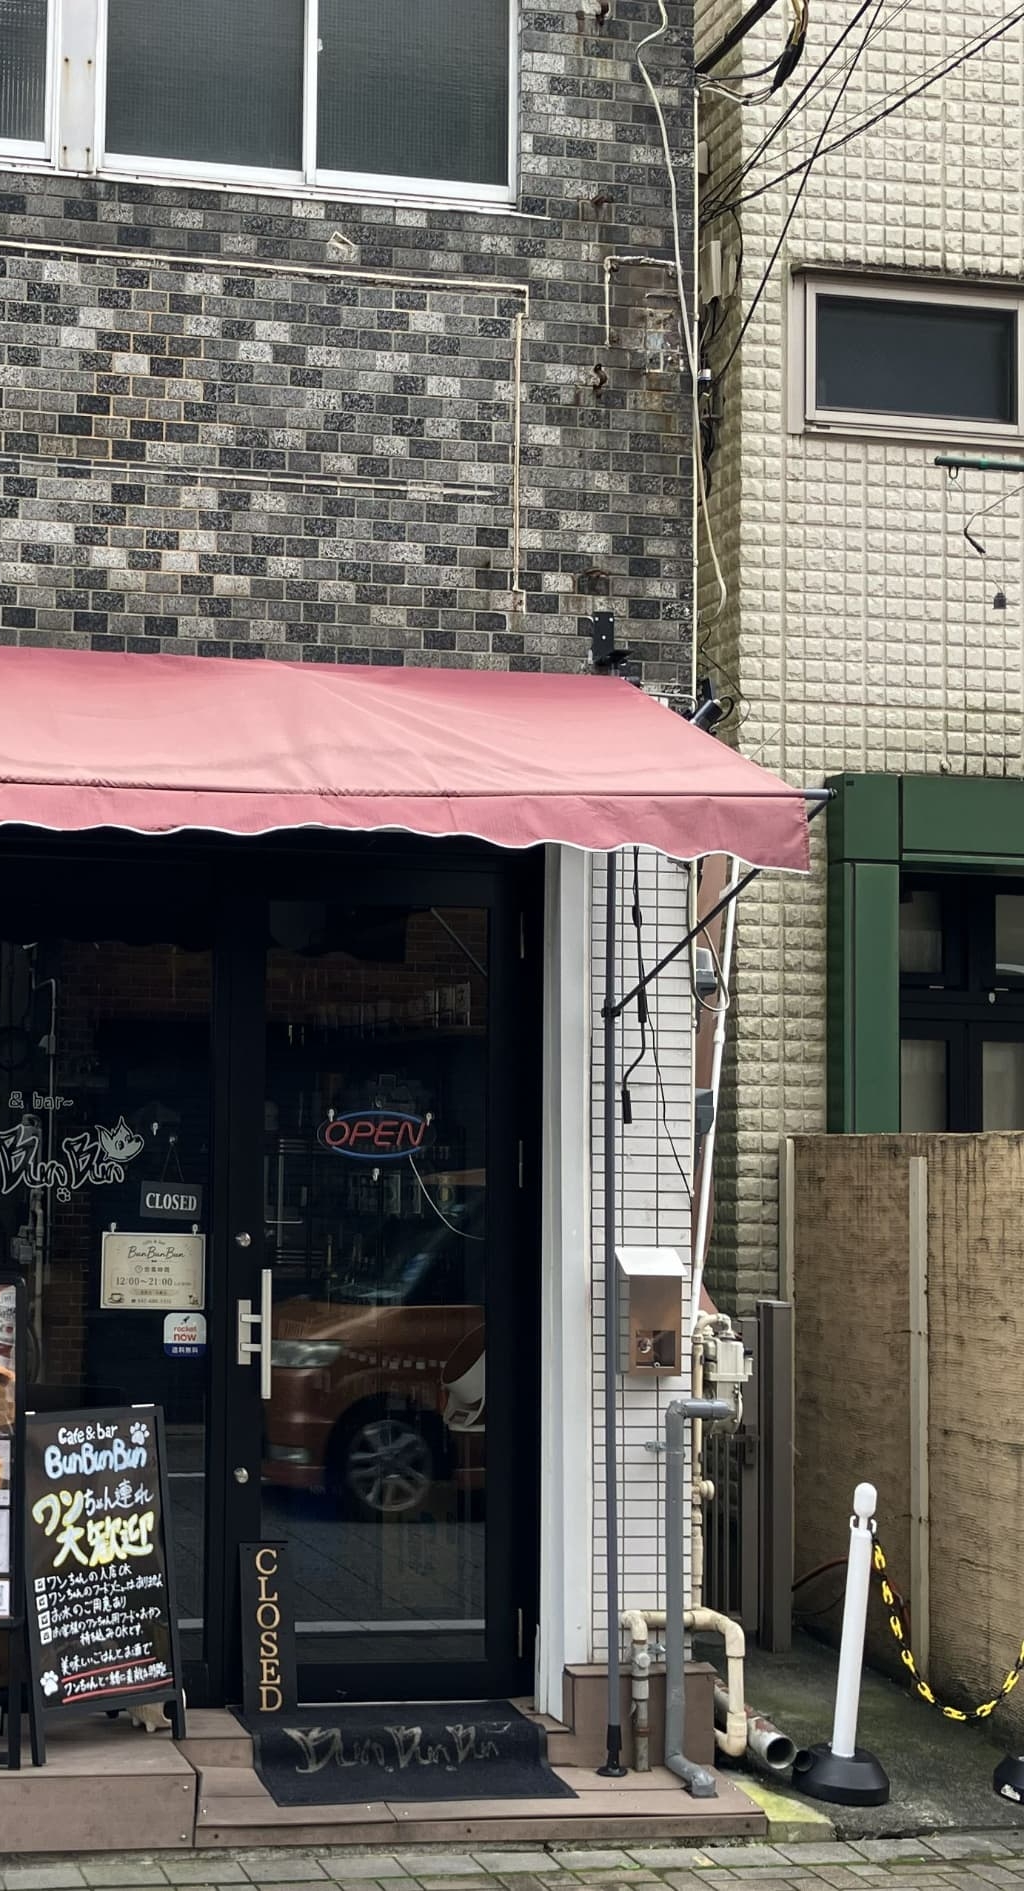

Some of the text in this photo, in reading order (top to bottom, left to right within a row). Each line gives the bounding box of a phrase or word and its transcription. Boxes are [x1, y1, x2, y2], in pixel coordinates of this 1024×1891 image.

[9, 1091, 24, 1109] &
[325, 1121, 426, 1146] OPEN
[145, 1192, 197, 1211] CLOSED
[127, 1245, 185, 1260] BunBunBun
[173, 1333, 197, 1342] now
[44, 1438, 148, 1480] BunBunBun
[52, 1511, 155, 1568] 大歓迎
[255, 1548, 283, 1712] CLOSED
